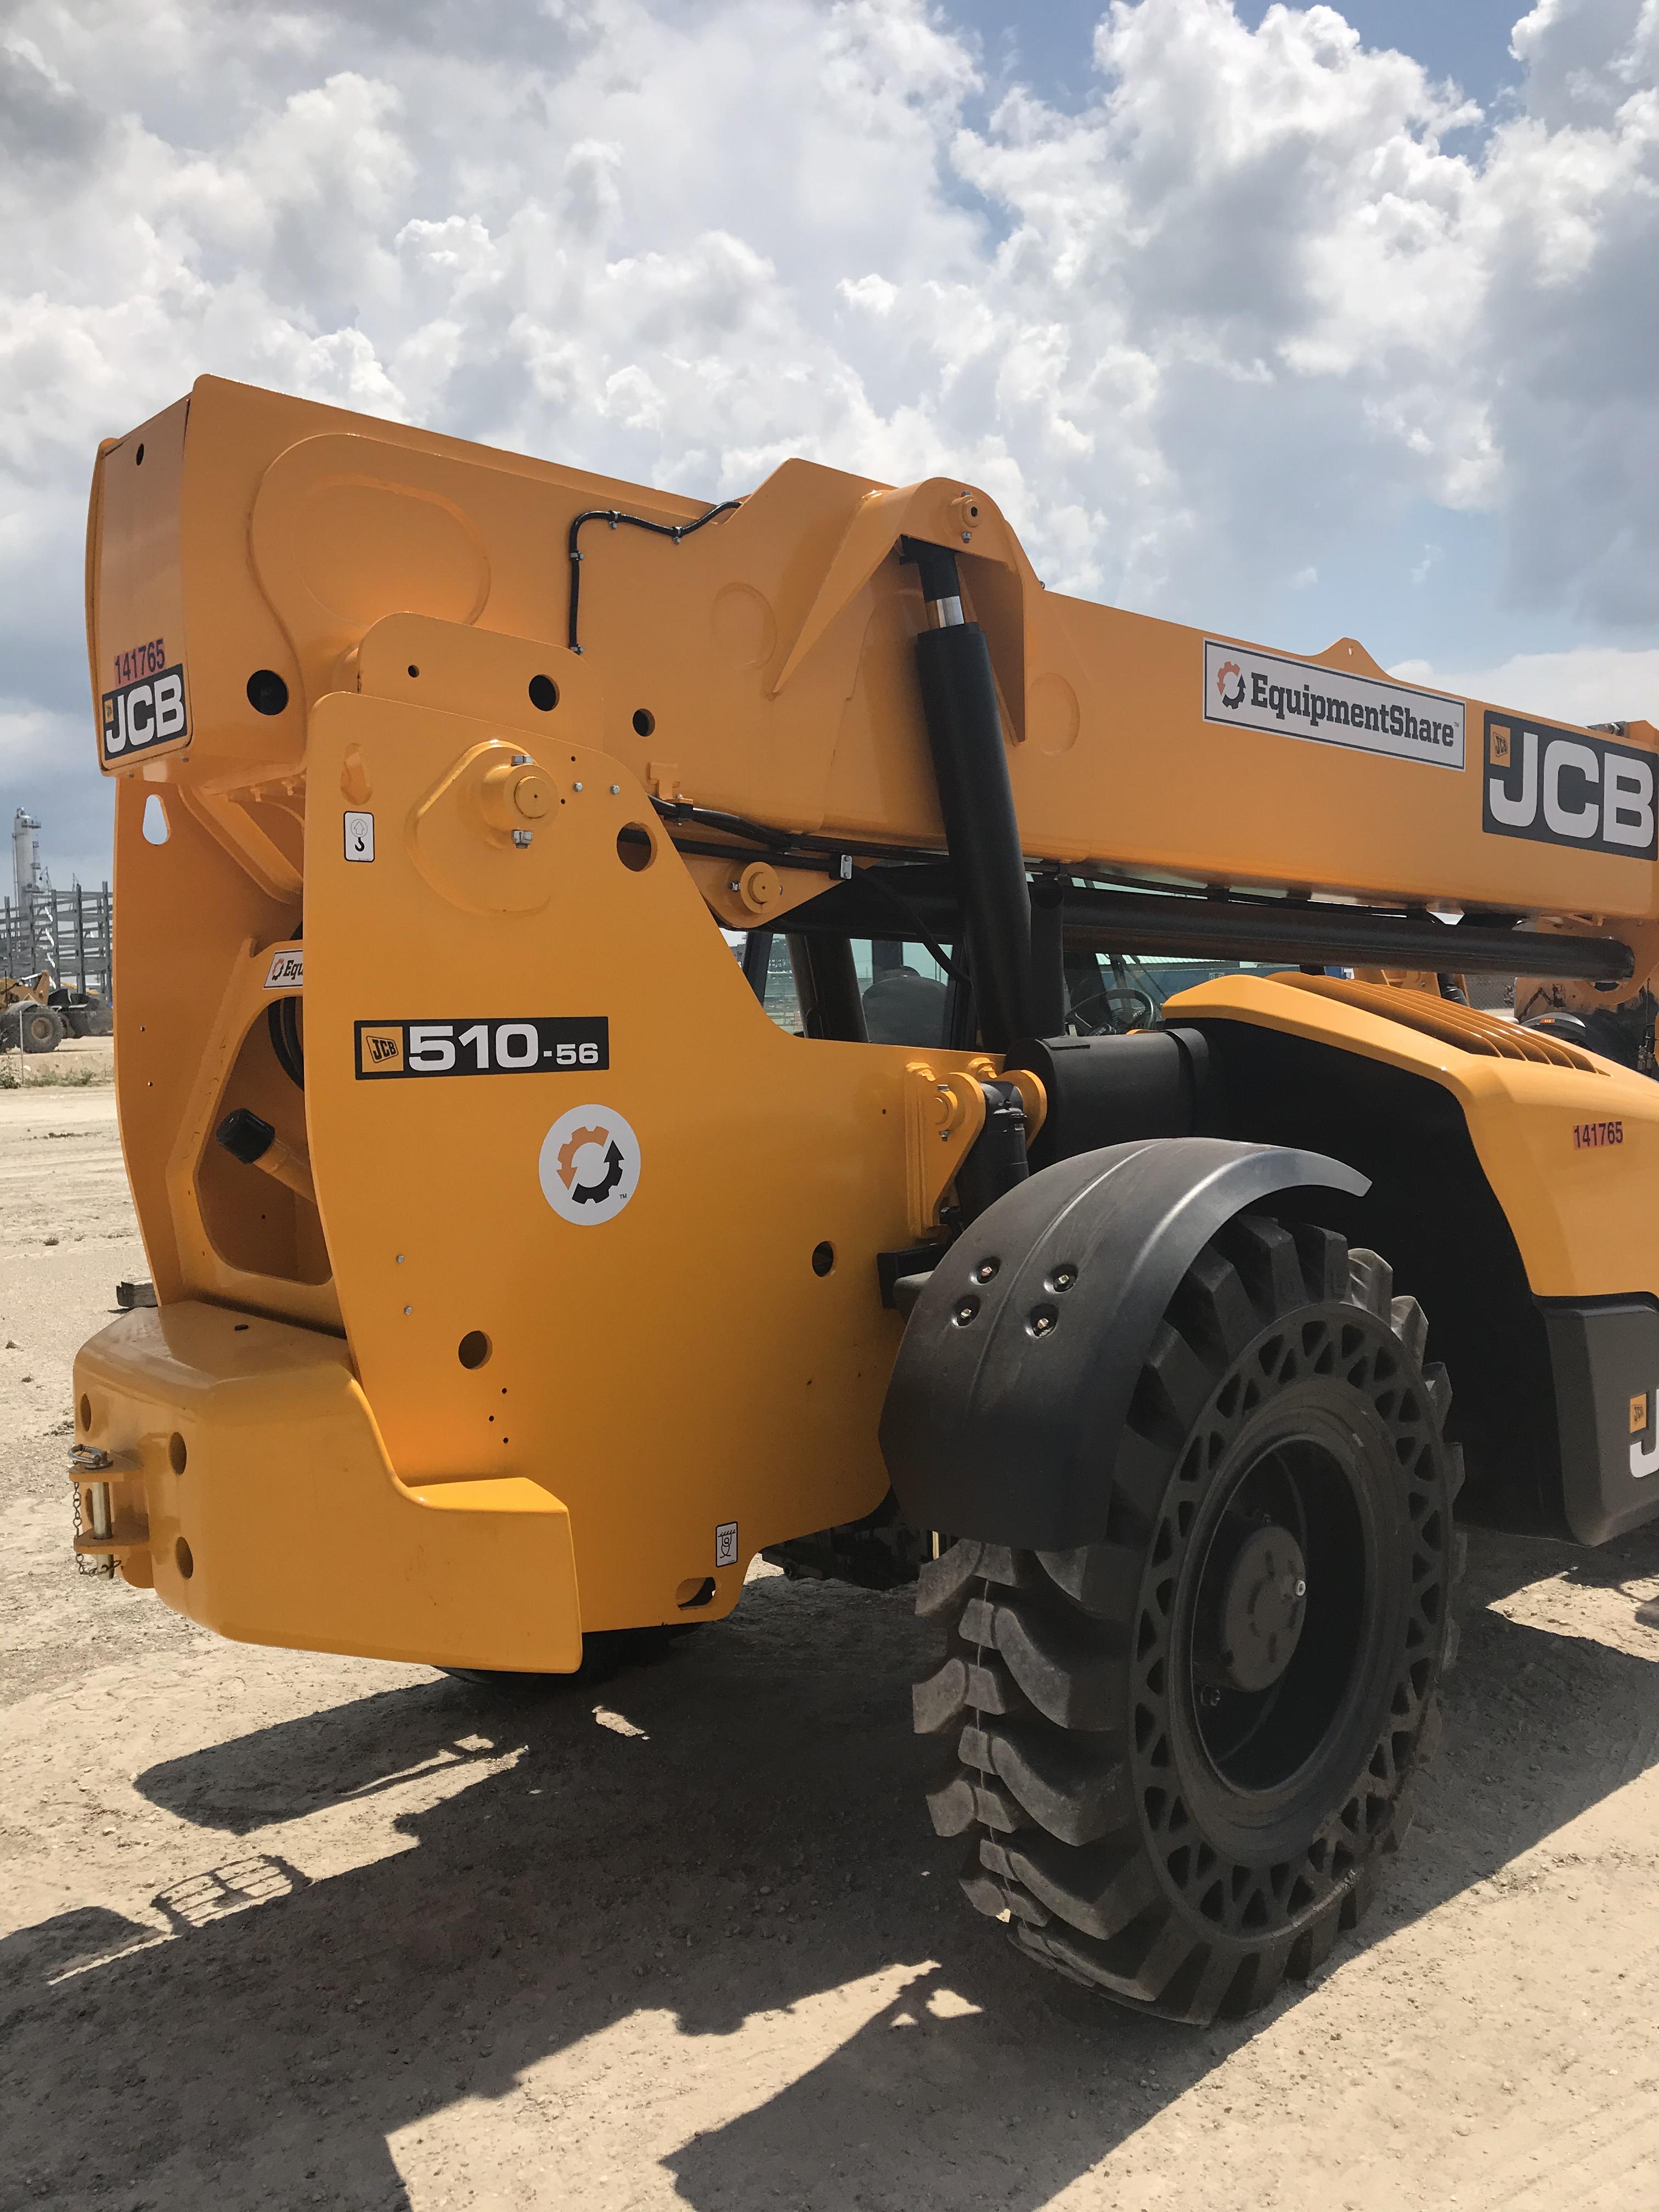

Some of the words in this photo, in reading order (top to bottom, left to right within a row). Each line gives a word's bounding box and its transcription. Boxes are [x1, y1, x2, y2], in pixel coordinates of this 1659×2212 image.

[115, 639, 165, 684] 141765
[106, 674, 184, 753] JCB
[1251, 672, 1454, 747] EquipmentShare
[1489, 732, 1654, 848] JCB
[372, 1039, 397, 1060] JCB
[409, 1024, 599, 1071] 510-56
[1574, 1121, 1623, 1148] 141765
